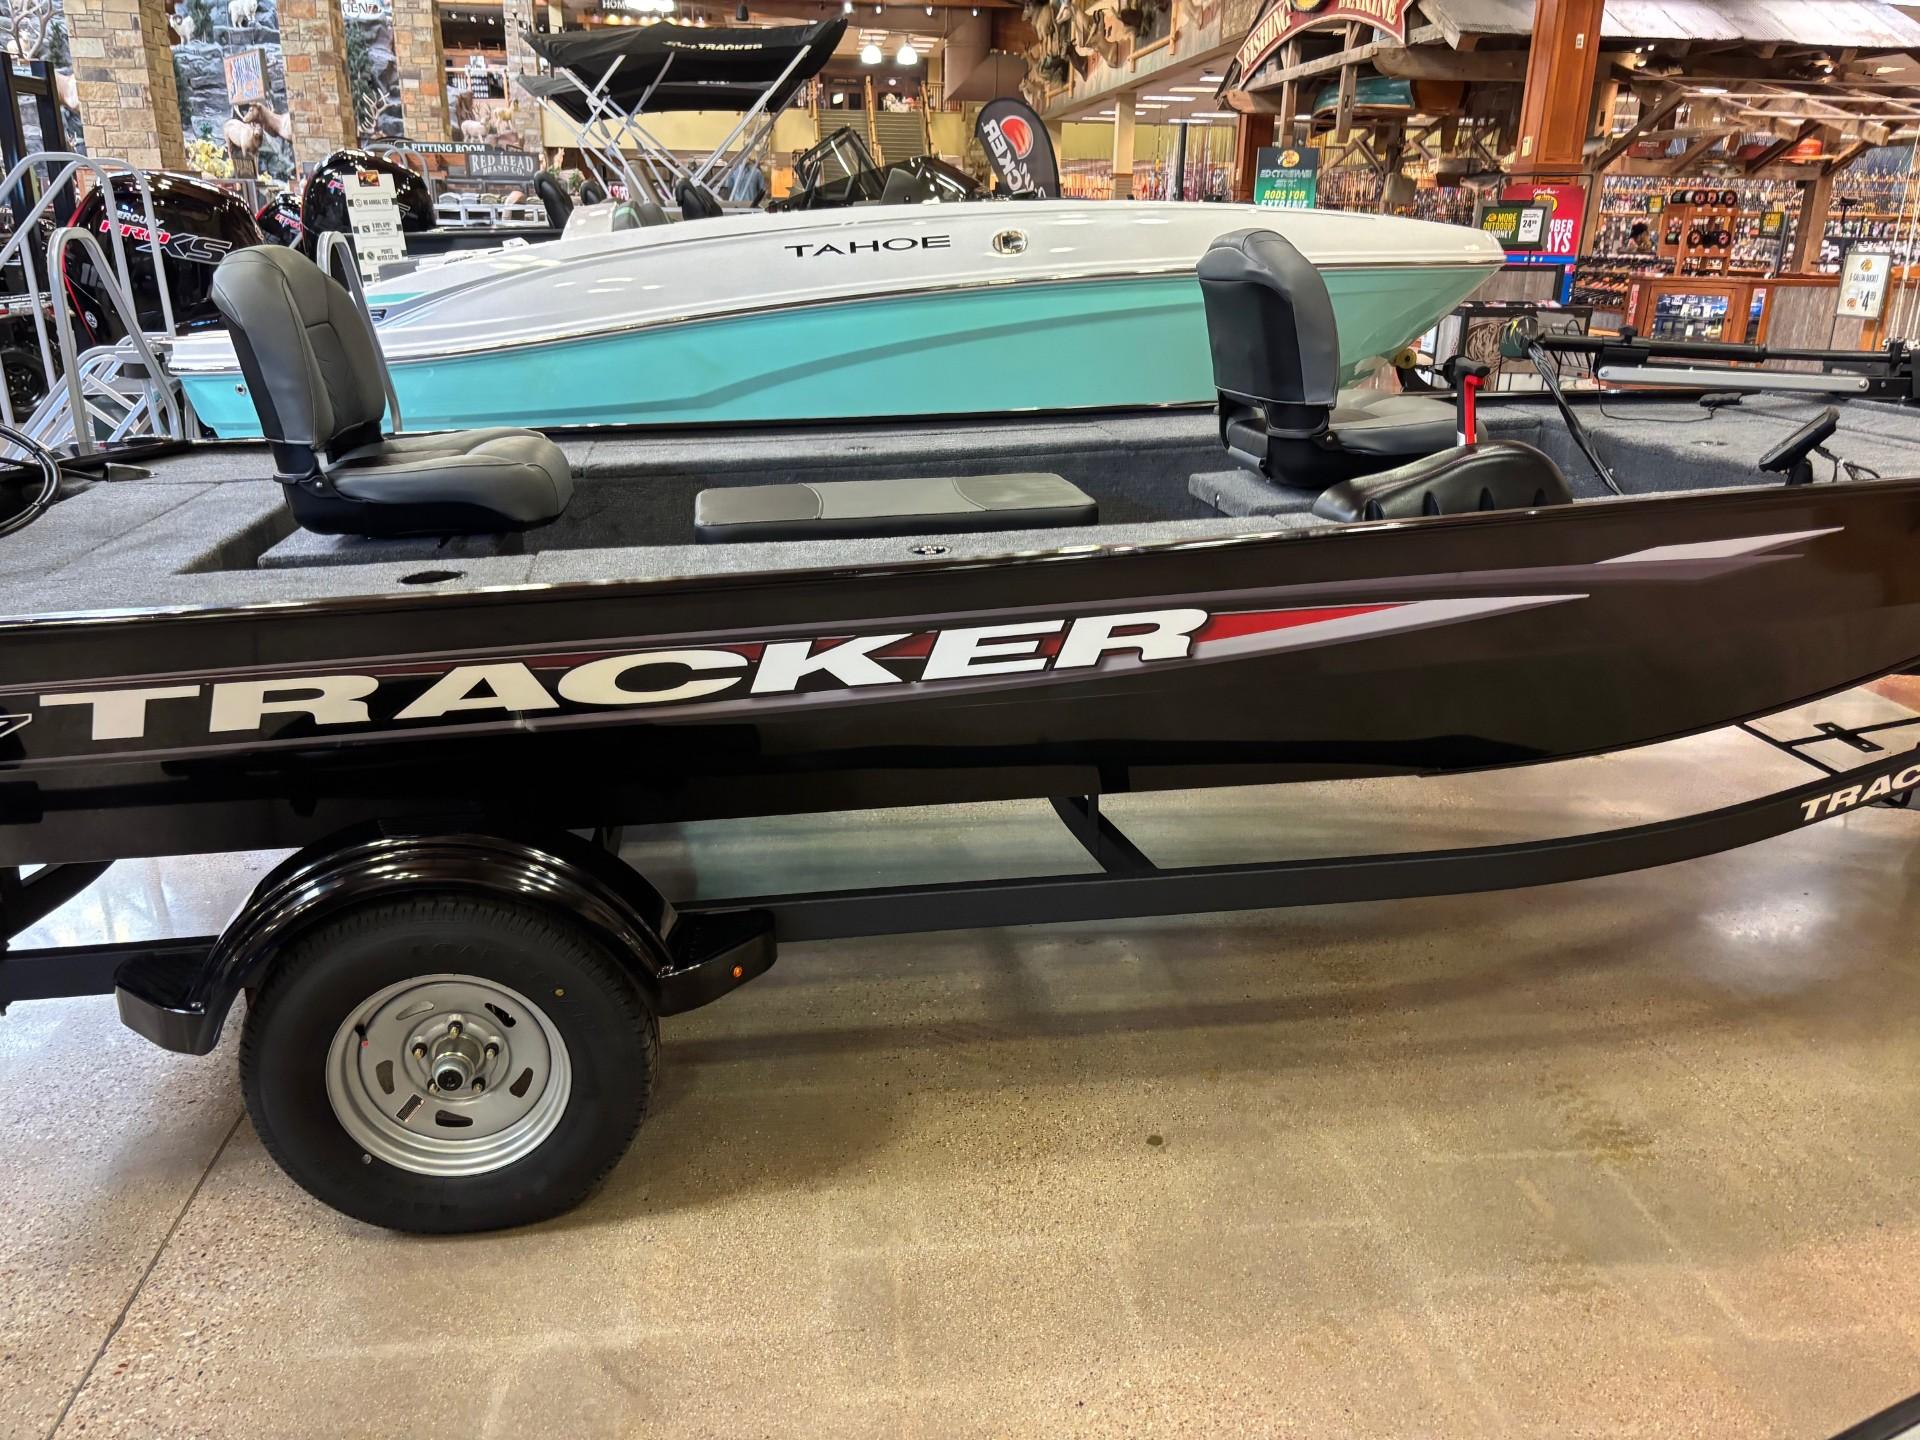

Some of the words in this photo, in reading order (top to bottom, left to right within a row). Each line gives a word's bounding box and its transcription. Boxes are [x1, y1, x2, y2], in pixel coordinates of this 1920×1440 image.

[1242, 1, 1292, 72] FISHING
[411, 143, 453, 152] FITTING
[455, 144, 486, 153] ROOM
[470, 154, 496, 172] RED
[500, 152, 534, 172] HEAD
[482, 165, 509, 176] BRAND
[511, 166, 525, 176] CO.
[1264, 190, 1287, 200] RODS
[1289, 190, 1307, 200] FOR
[1483, 222, 1516, 231] OUTDOORS
[1497, 213, 1517, 223] MORE
[136, 233, 233, 265] XS
[784, 235, 951, 258] TAHOE
[1547, 232, 1572, 253] AYS
[39, 608, 1209, 741] TRACKER
